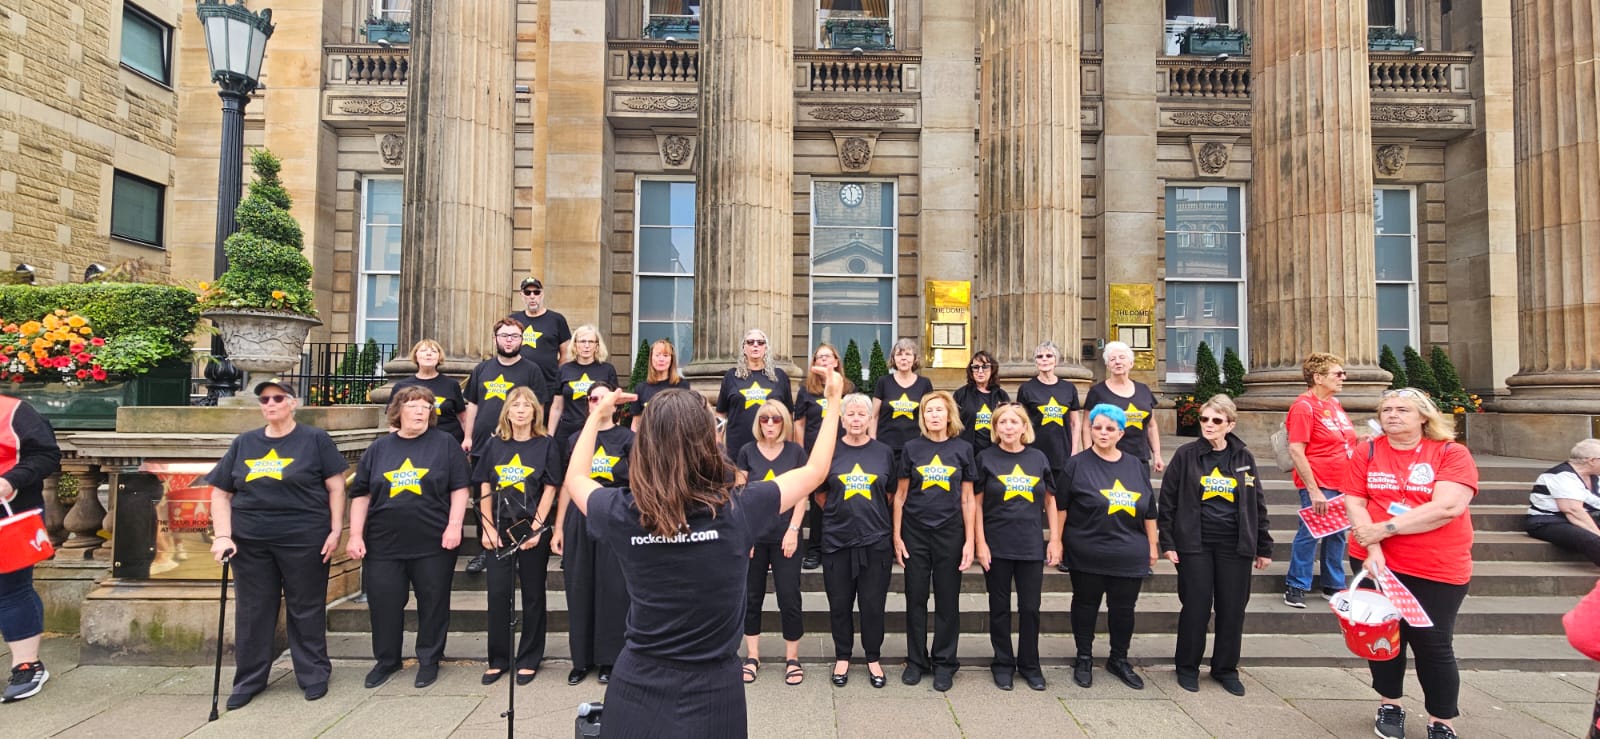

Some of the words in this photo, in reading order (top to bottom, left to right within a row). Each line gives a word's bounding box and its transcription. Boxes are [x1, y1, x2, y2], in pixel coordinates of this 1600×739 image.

[393, 471, 418, 479] ROCK
[389, 479, 421, 487] CHOIR
[1202, 486, 1235, 494] CHOIR
[1108, 499, 1136, 507] CHOIR
[630, 529, 719, 546] rockchoir.com
